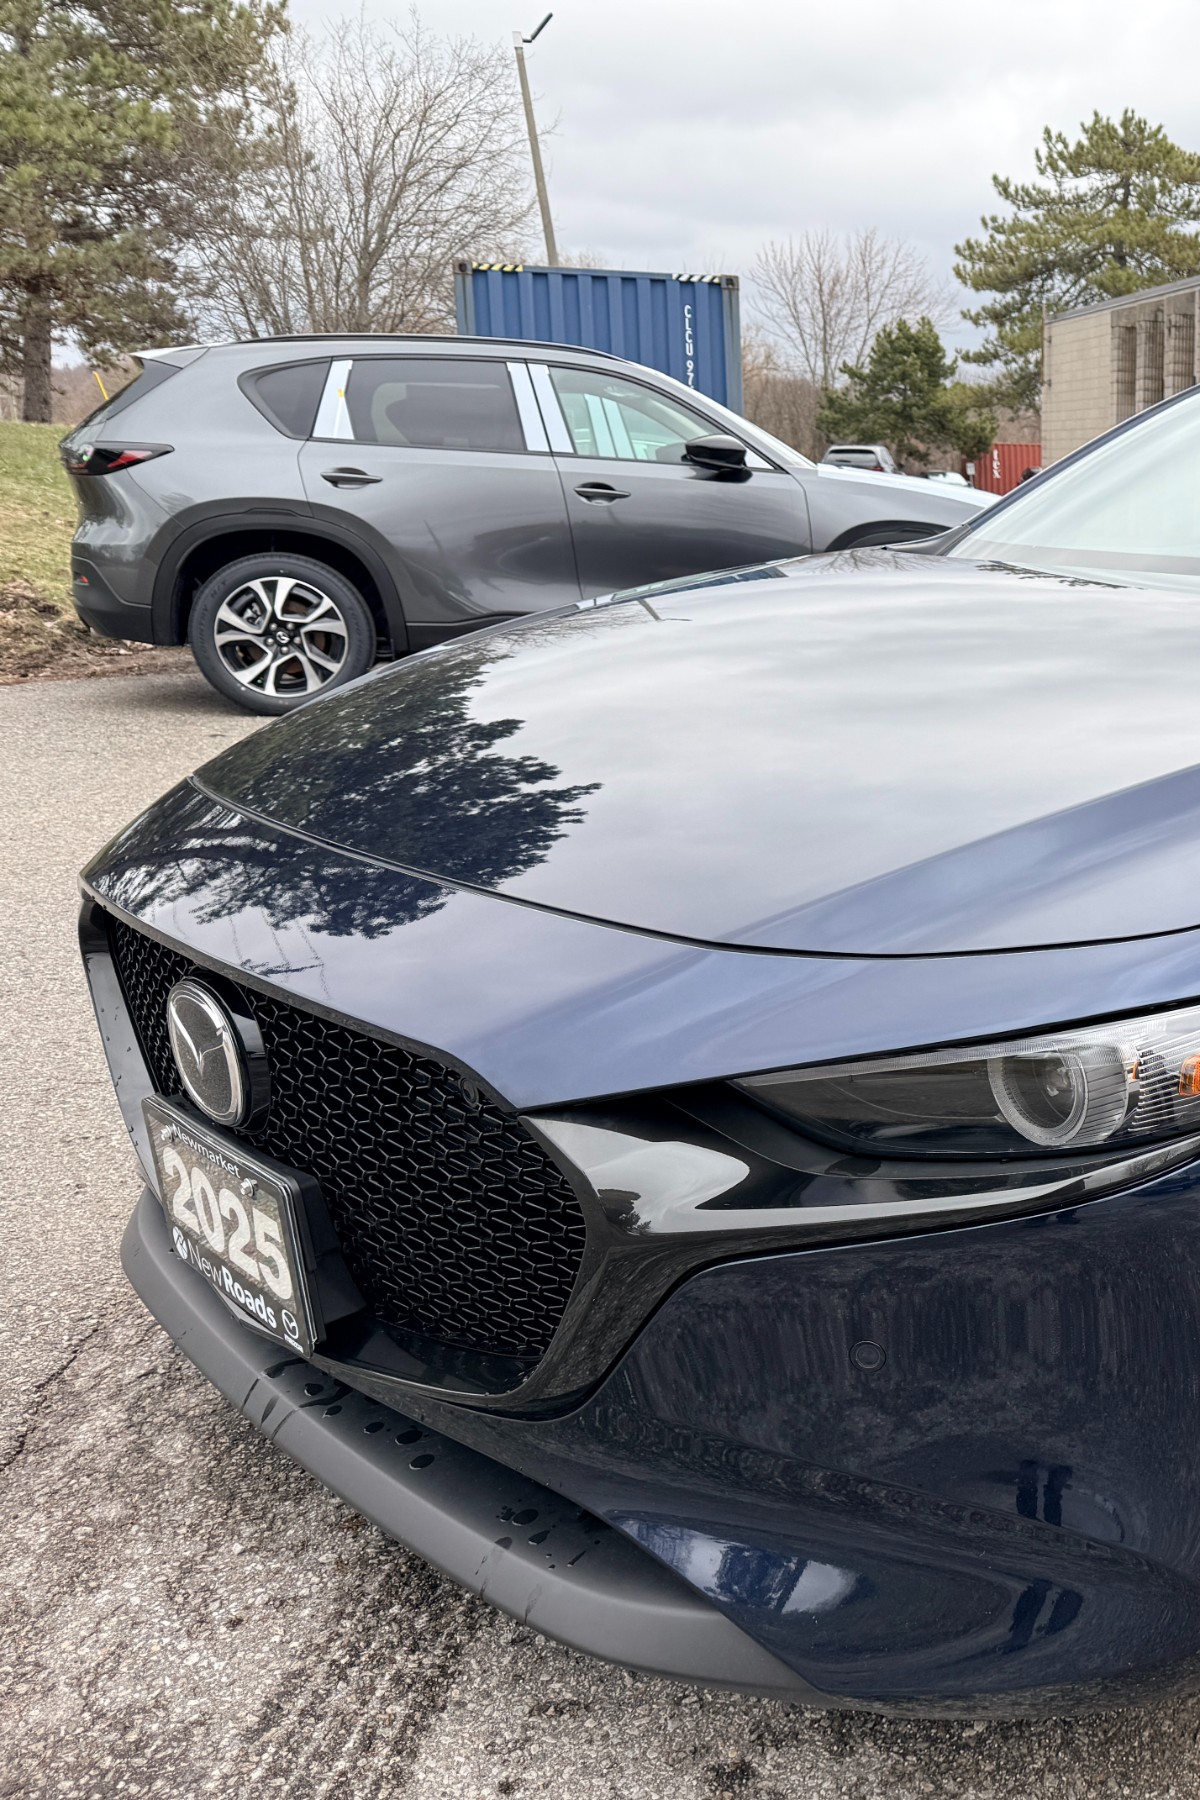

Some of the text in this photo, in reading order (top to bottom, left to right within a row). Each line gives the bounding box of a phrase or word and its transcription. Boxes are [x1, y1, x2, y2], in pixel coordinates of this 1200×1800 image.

[684, 304, 695, 389] CLCU 97
[172, 1123, 241, 1179] Newmarket
[162, 1146, 293, 1300] 2025
